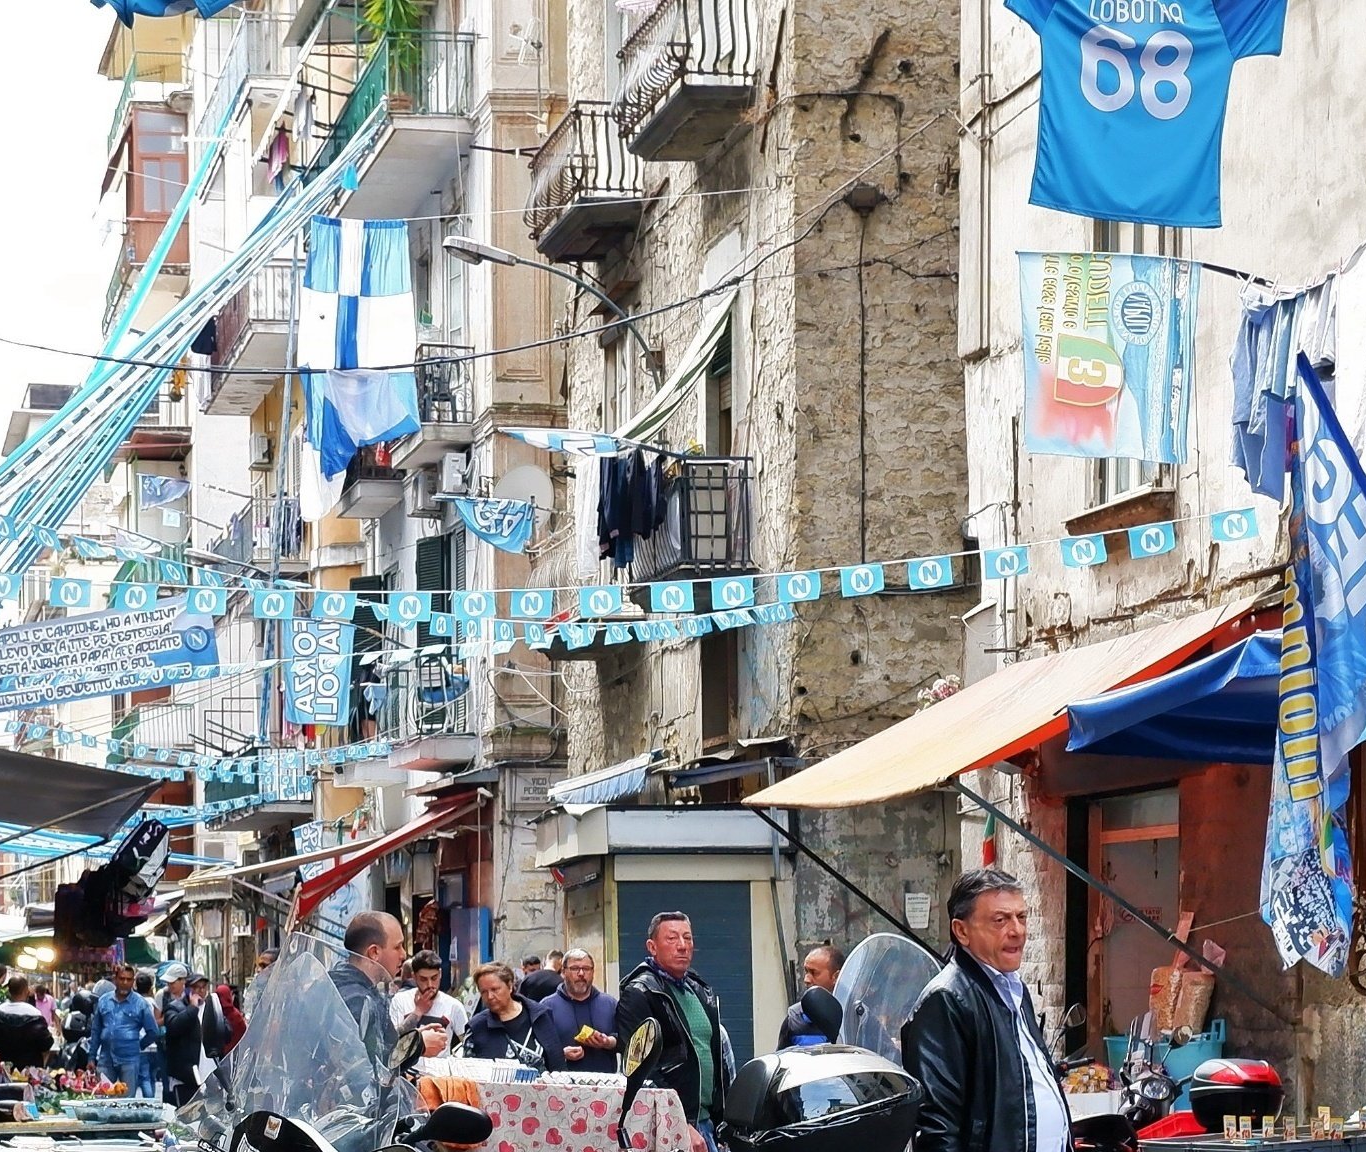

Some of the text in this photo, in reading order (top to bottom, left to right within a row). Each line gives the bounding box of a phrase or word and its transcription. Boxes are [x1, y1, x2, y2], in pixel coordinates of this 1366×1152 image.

[1081, 24, 1194, 120] 68
[124, 615, 131, 626] A
[531, 777, 547, 785] VICO
